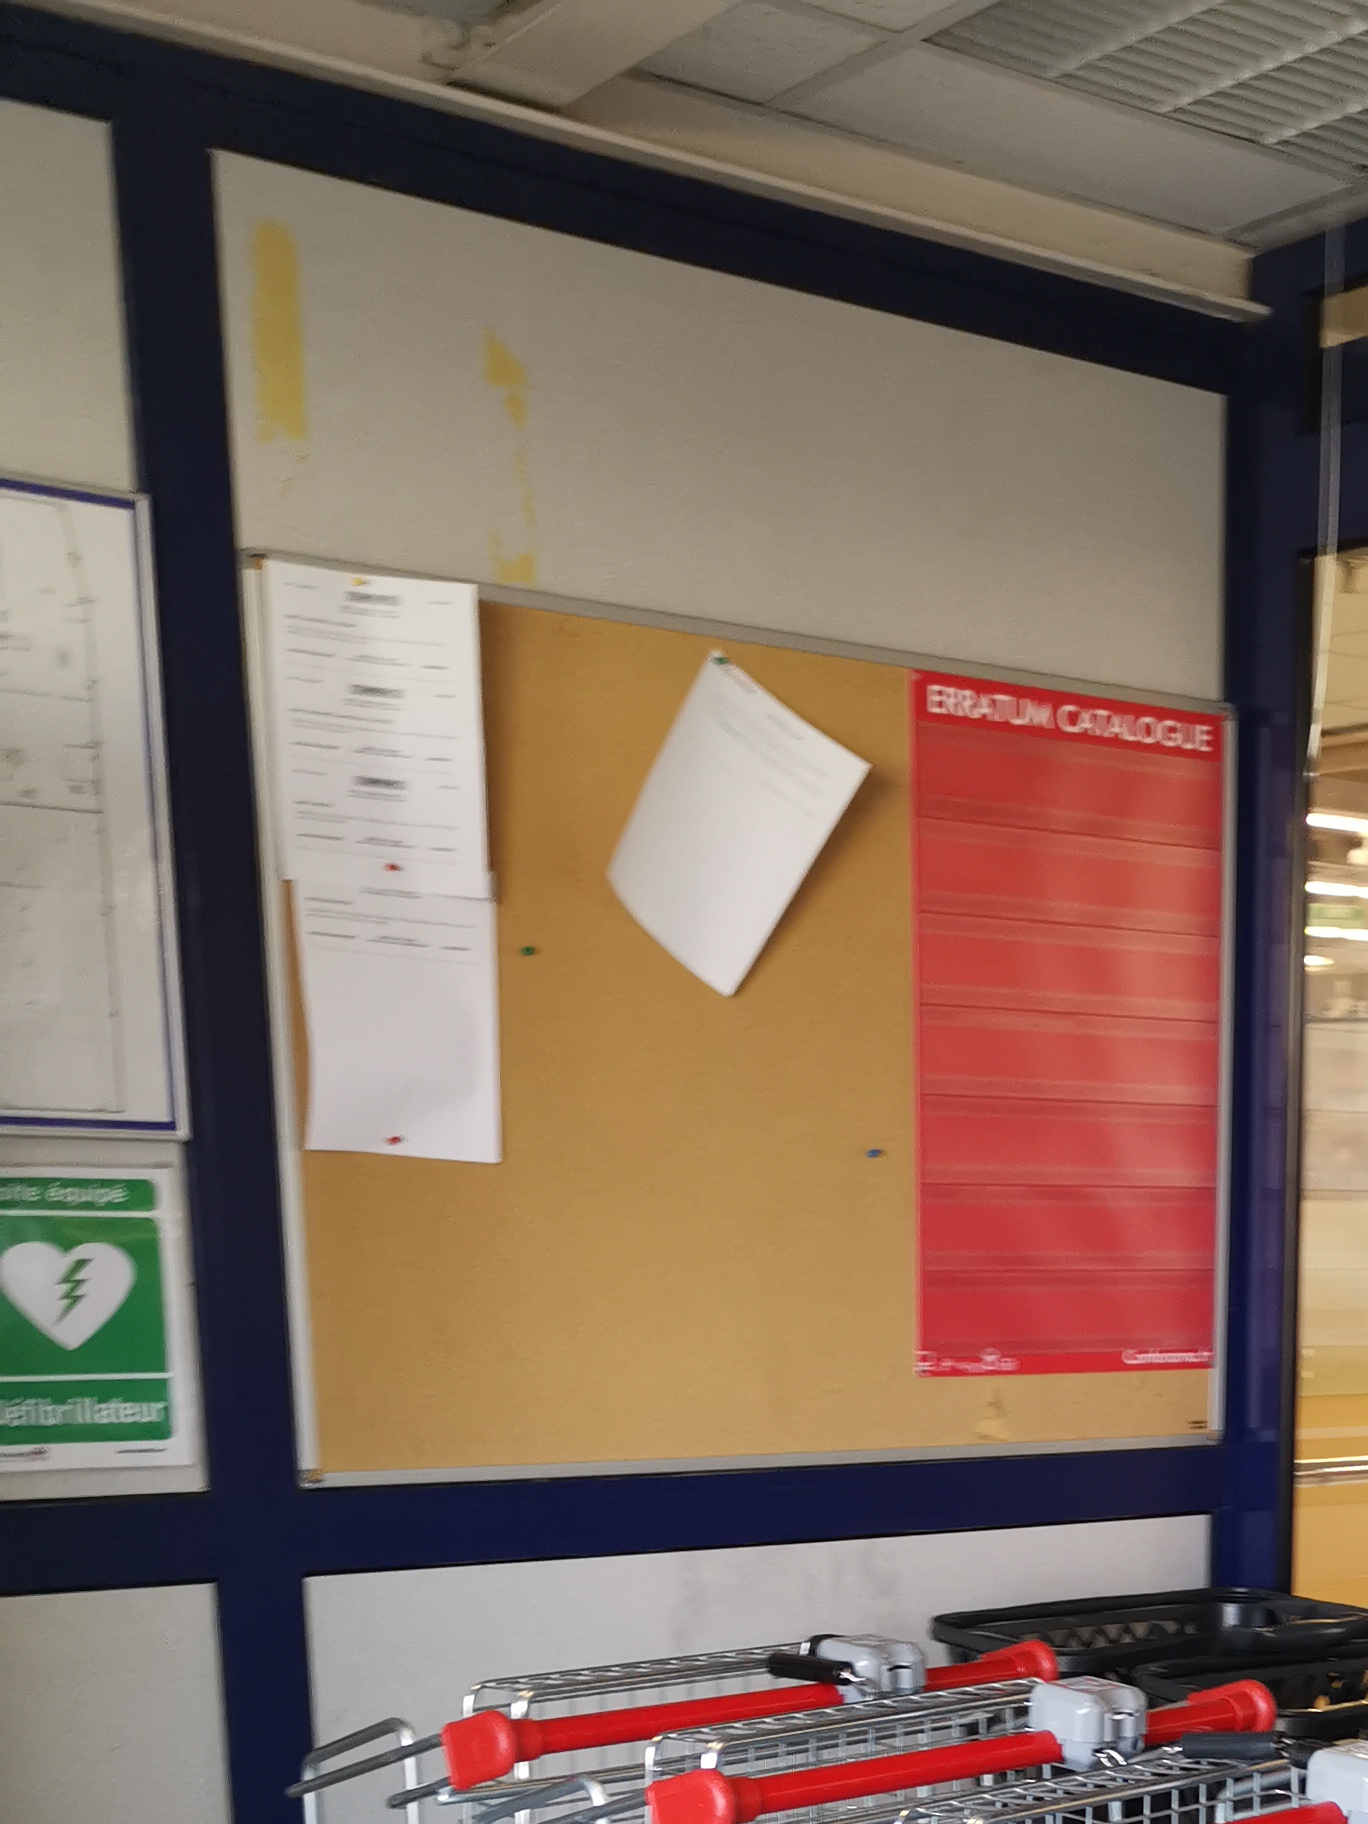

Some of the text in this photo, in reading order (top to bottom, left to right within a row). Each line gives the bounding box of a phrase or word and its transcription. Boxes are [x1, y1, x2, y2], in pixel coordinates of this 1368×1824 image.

[926, 684, 1215, 752] ERRATUM CATALOGUE
[0, 1397, 168, 1427] éfibrillateur
